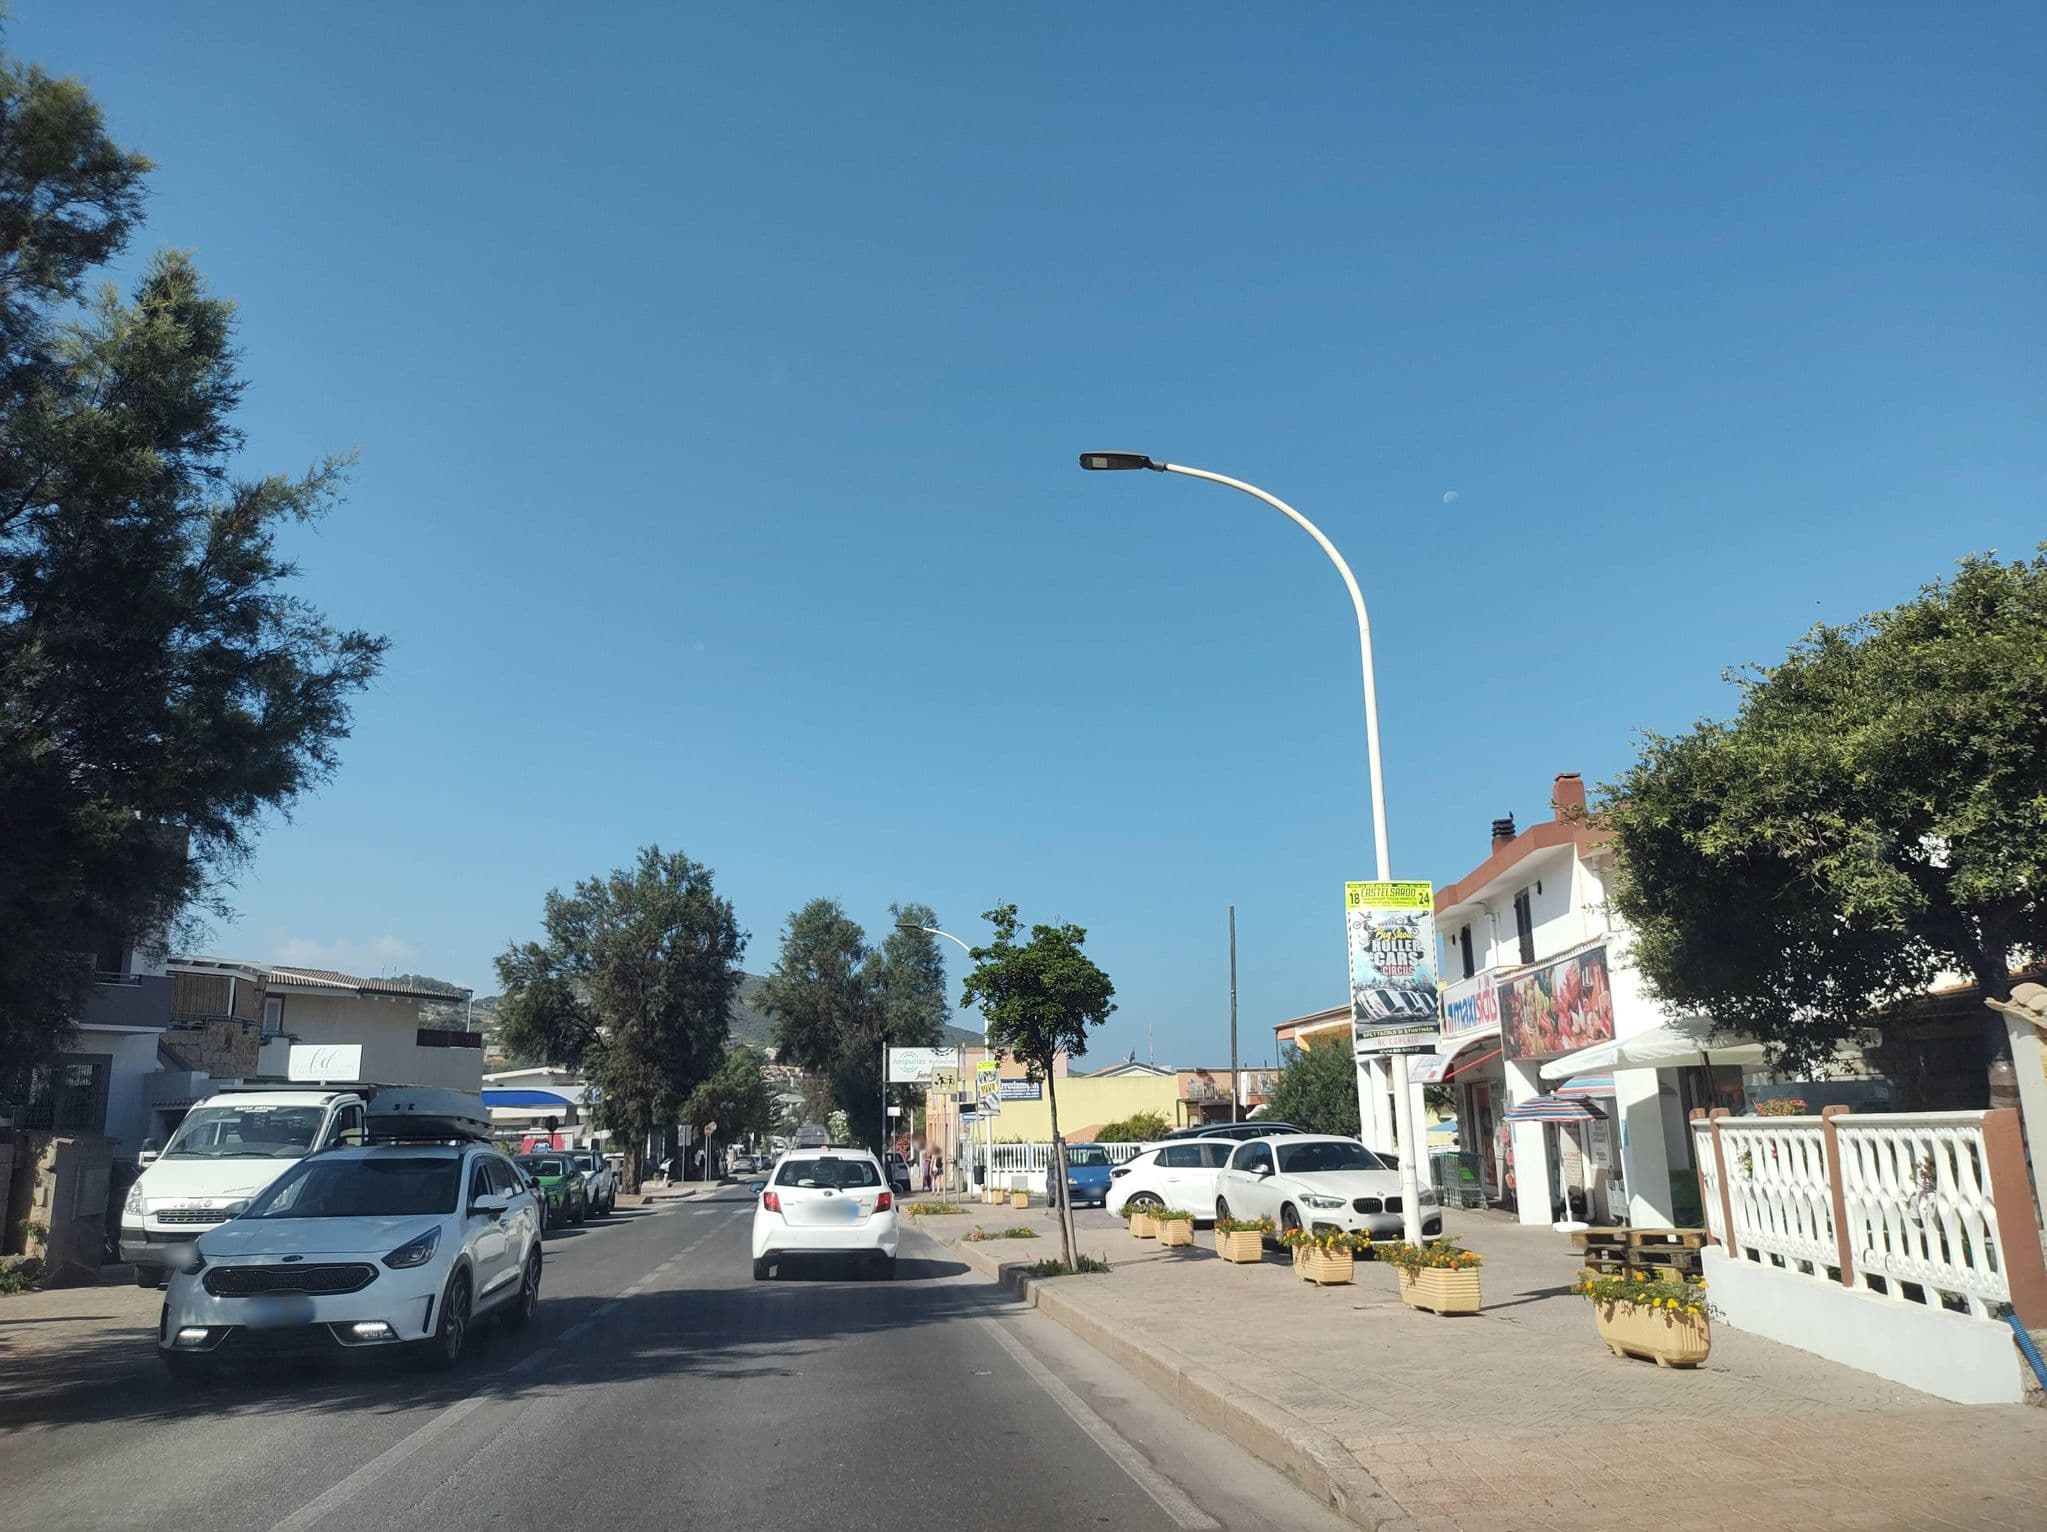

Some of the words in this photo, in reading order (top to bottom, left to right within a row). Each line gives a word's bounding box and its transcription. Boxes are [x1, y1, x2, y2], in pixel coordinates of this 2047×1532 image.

[1361, 887, 1416, 897] CASTELSARDO
[1349, 893, 1360, 904] 18
[1418, 892, 1430, 904] 24
[1374, 951, 1418, 966] CARS
[1382, 965, 1415, 976] CIRCUS
